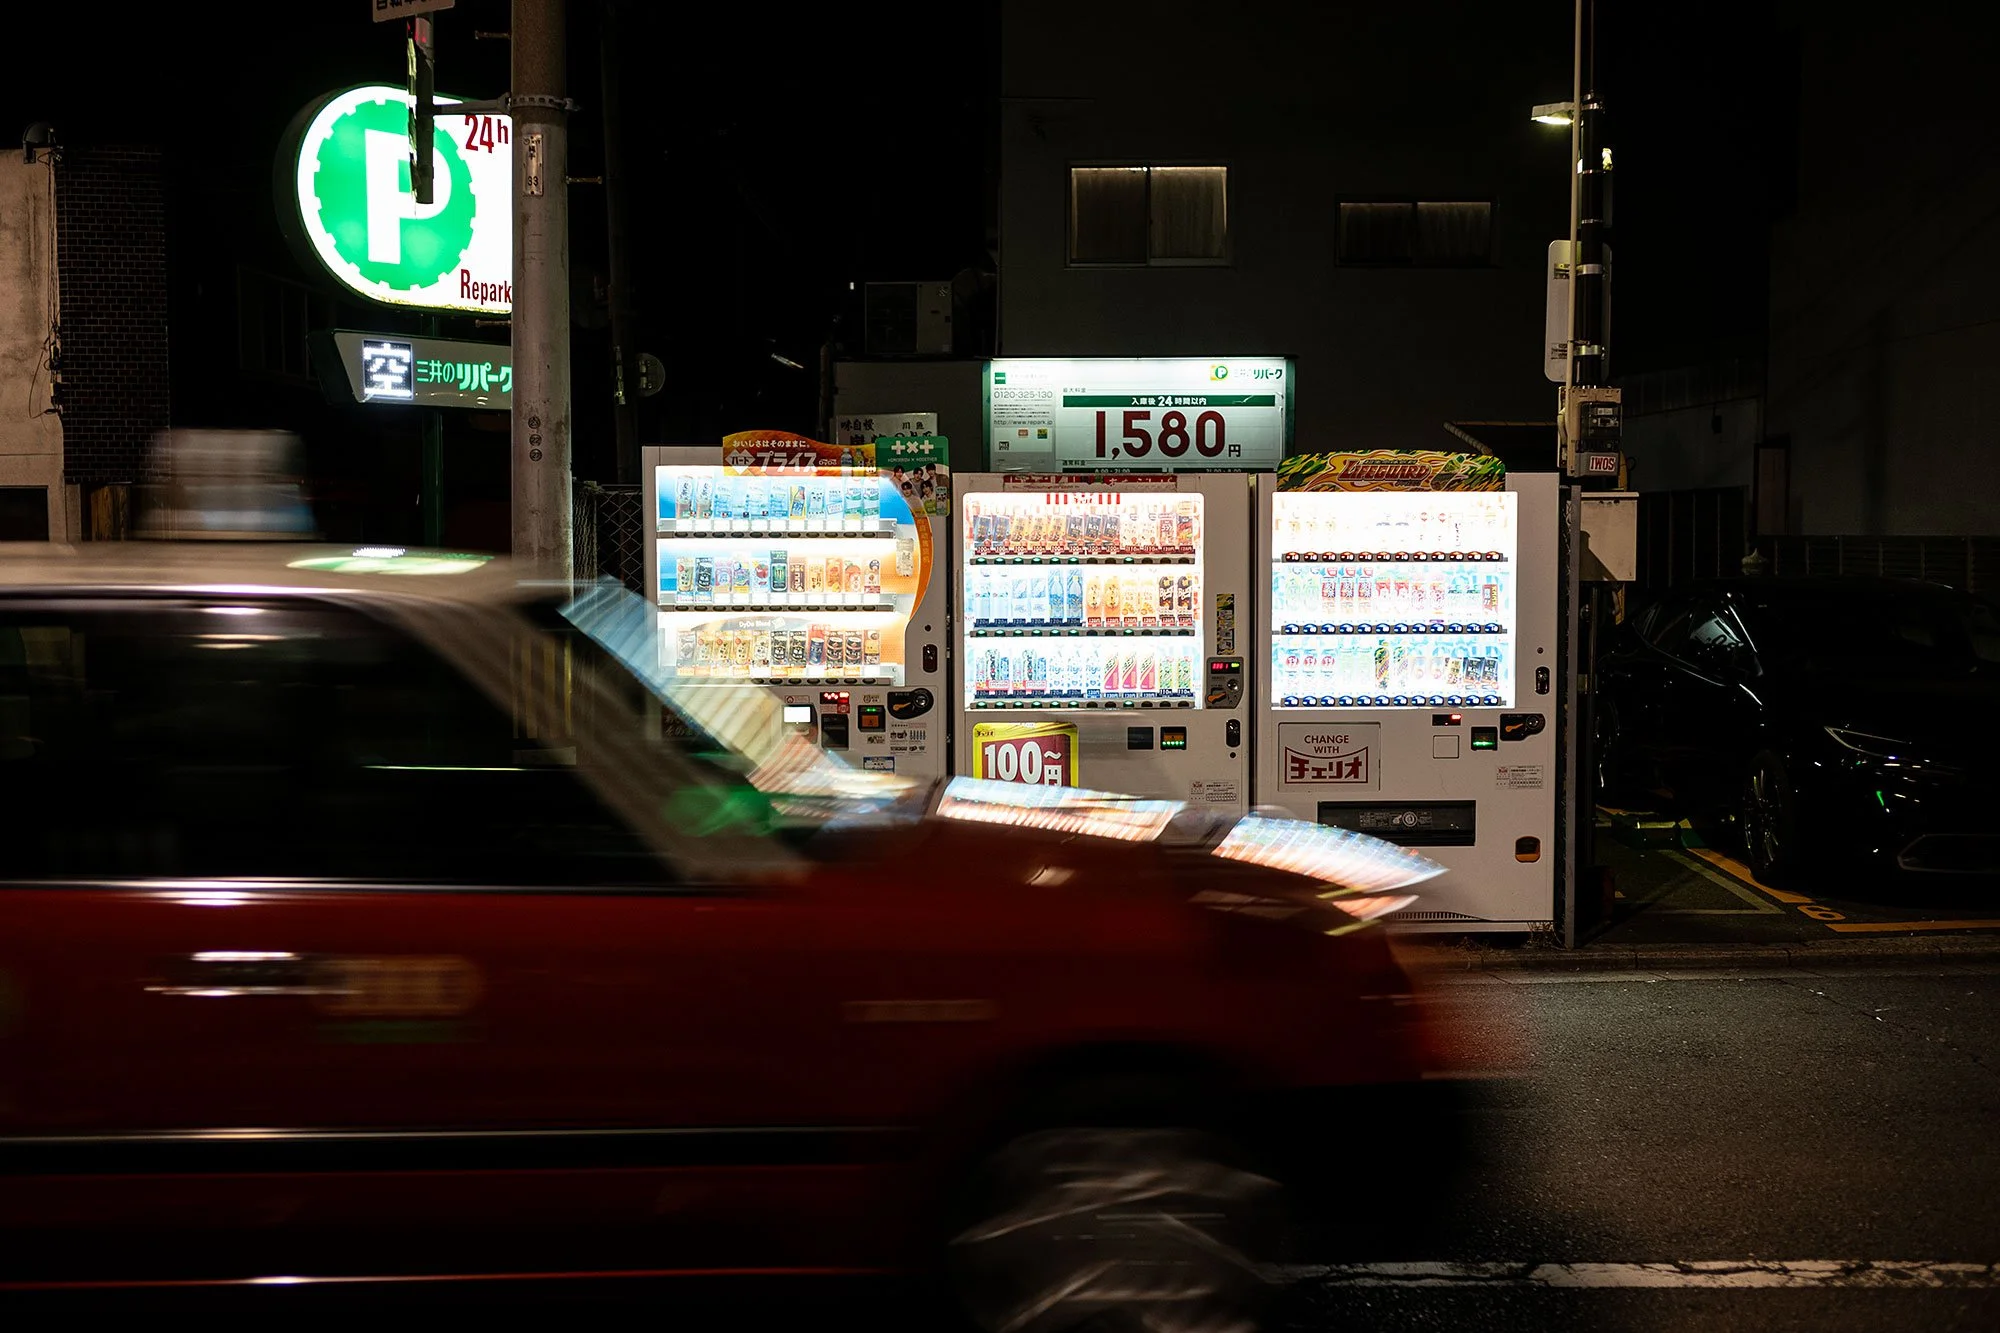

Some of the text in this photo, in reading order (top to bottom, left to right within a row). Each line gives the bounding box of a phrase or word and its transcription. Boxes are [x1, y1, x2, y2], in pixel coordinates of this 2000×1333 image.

[465, 114, 509, 153] 24h
[460, 268, 512, 305] Repark
[363, 341, 412, 398] 空
[732, 440, 811, 449] おいしさはそのままに。
[756, 450, 819, 473] プライス
[1337, 459, 1432, 482] LIFEGUARD
[1304, 735, 1349, 744] CHANGE
[1313, 746, 1340, 754] WITH
[1290, 755, 1363, 780] チェリオ
